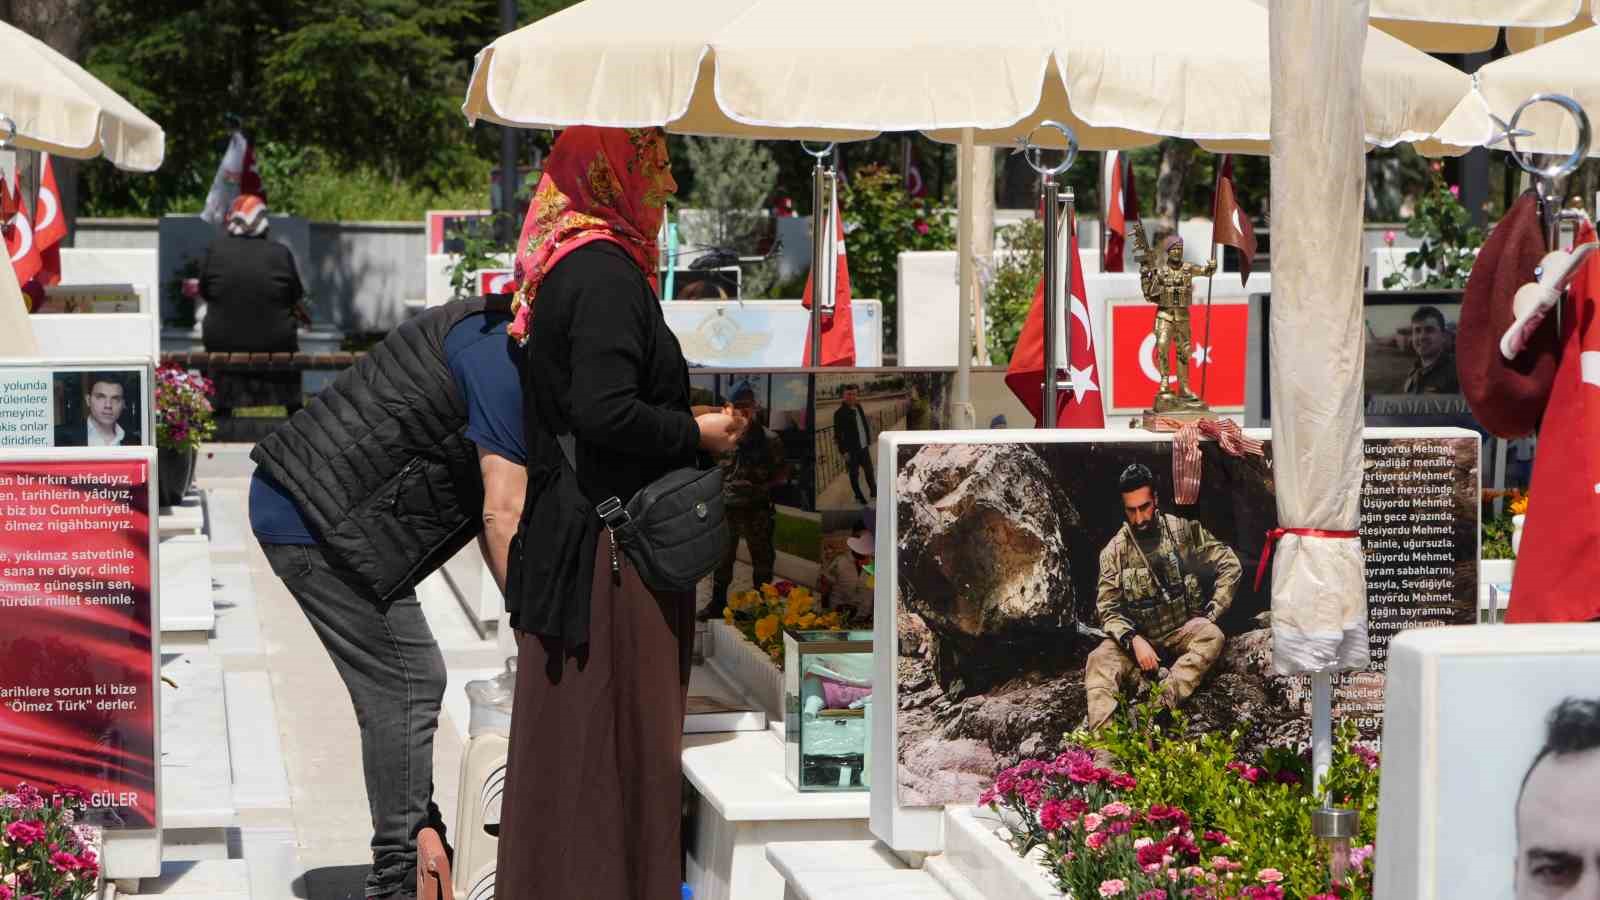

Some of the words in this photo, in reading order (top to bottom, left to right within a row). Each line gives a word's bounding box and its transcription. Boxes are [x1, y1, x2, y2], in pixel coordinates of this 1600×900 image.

[4, 380, 48, 393] yolunda
[0, 421, 17, 432] kis
[20, 421, 48, 432] onlar
[1412, 443, 1456, 455] Mehmet,
[17, 474, 34, 486] bir
[38, 474, 67, 485] ırkın
[71, 473, 133, 487] ahfadıyız,
[1361, 471, 1411, 482] erliyordu
[1412, 470, 1456, 482] Mehmet,
[22, 488, 80, 501] tarihlerin
[84, 488, 133, 502] yâdıyız,
[1397, 483, 1456, 495] mevzisinde,
[1412, 498, 1456, 509] Mehmet,
[7, 504, 26, 516] biz
[30, 504, 46, 516] bu
[50, 503, 134, 517] Cumhuriyeti,
[1360, 512, 1382, 523] ağın
[1384, 513, 1407, 523] gece
[1409, 511, 1456, 523] ayazında,
[5, 519, 43, 532] ölmez
[47, 518, 134, 533] nigâhbanıyız.
[1358, 526, 1410, 537] eleşiyordu
[1412, 525, 1456, 536] Mehmet,
[1367, 539, 1401, 549] hainle,
[1403, 538, 1455, 550] uğursuzla.
[15, 549, 68, 564] yıkılmaz
[71, 548, 134, 560] satvetinle
[1412, 552, 1456, 562] Mehmet,
[4, 567, 34, 577] sana
[38, 566, 54, 576] ne
[59, 564, 95, 578] diyor,
[98, 563, 135, 575] dinle:
[1362, 567, 1395, 577] ayram
[1397, 565, 1456, 577] sabahlarını,
[44, 578, 104, 593] güneşsin
[107, 579, 135, 591] sen,
[1366, 579, 1400, 590] asıyla,
[1401, 578, 1456, 590] Sevdiğiyle.
[46, 595, 81, 607] millet
[84, 593, 135, 606] seninle.
[1412, 592, 1456, 604] Mehmet,
[1370, 606, 1398, 618] dağın
[1400, 606, 1456, 618] bayramına,
[0, 685, 50, 698] arihlere
[53, 686, 91, 696] sorun
[95, 683, 107, 695] ki
[111, 683, 137, 695] bize
[96, 698, 137, 711] derler.
[91, 788, 138, 807] GÜLER
